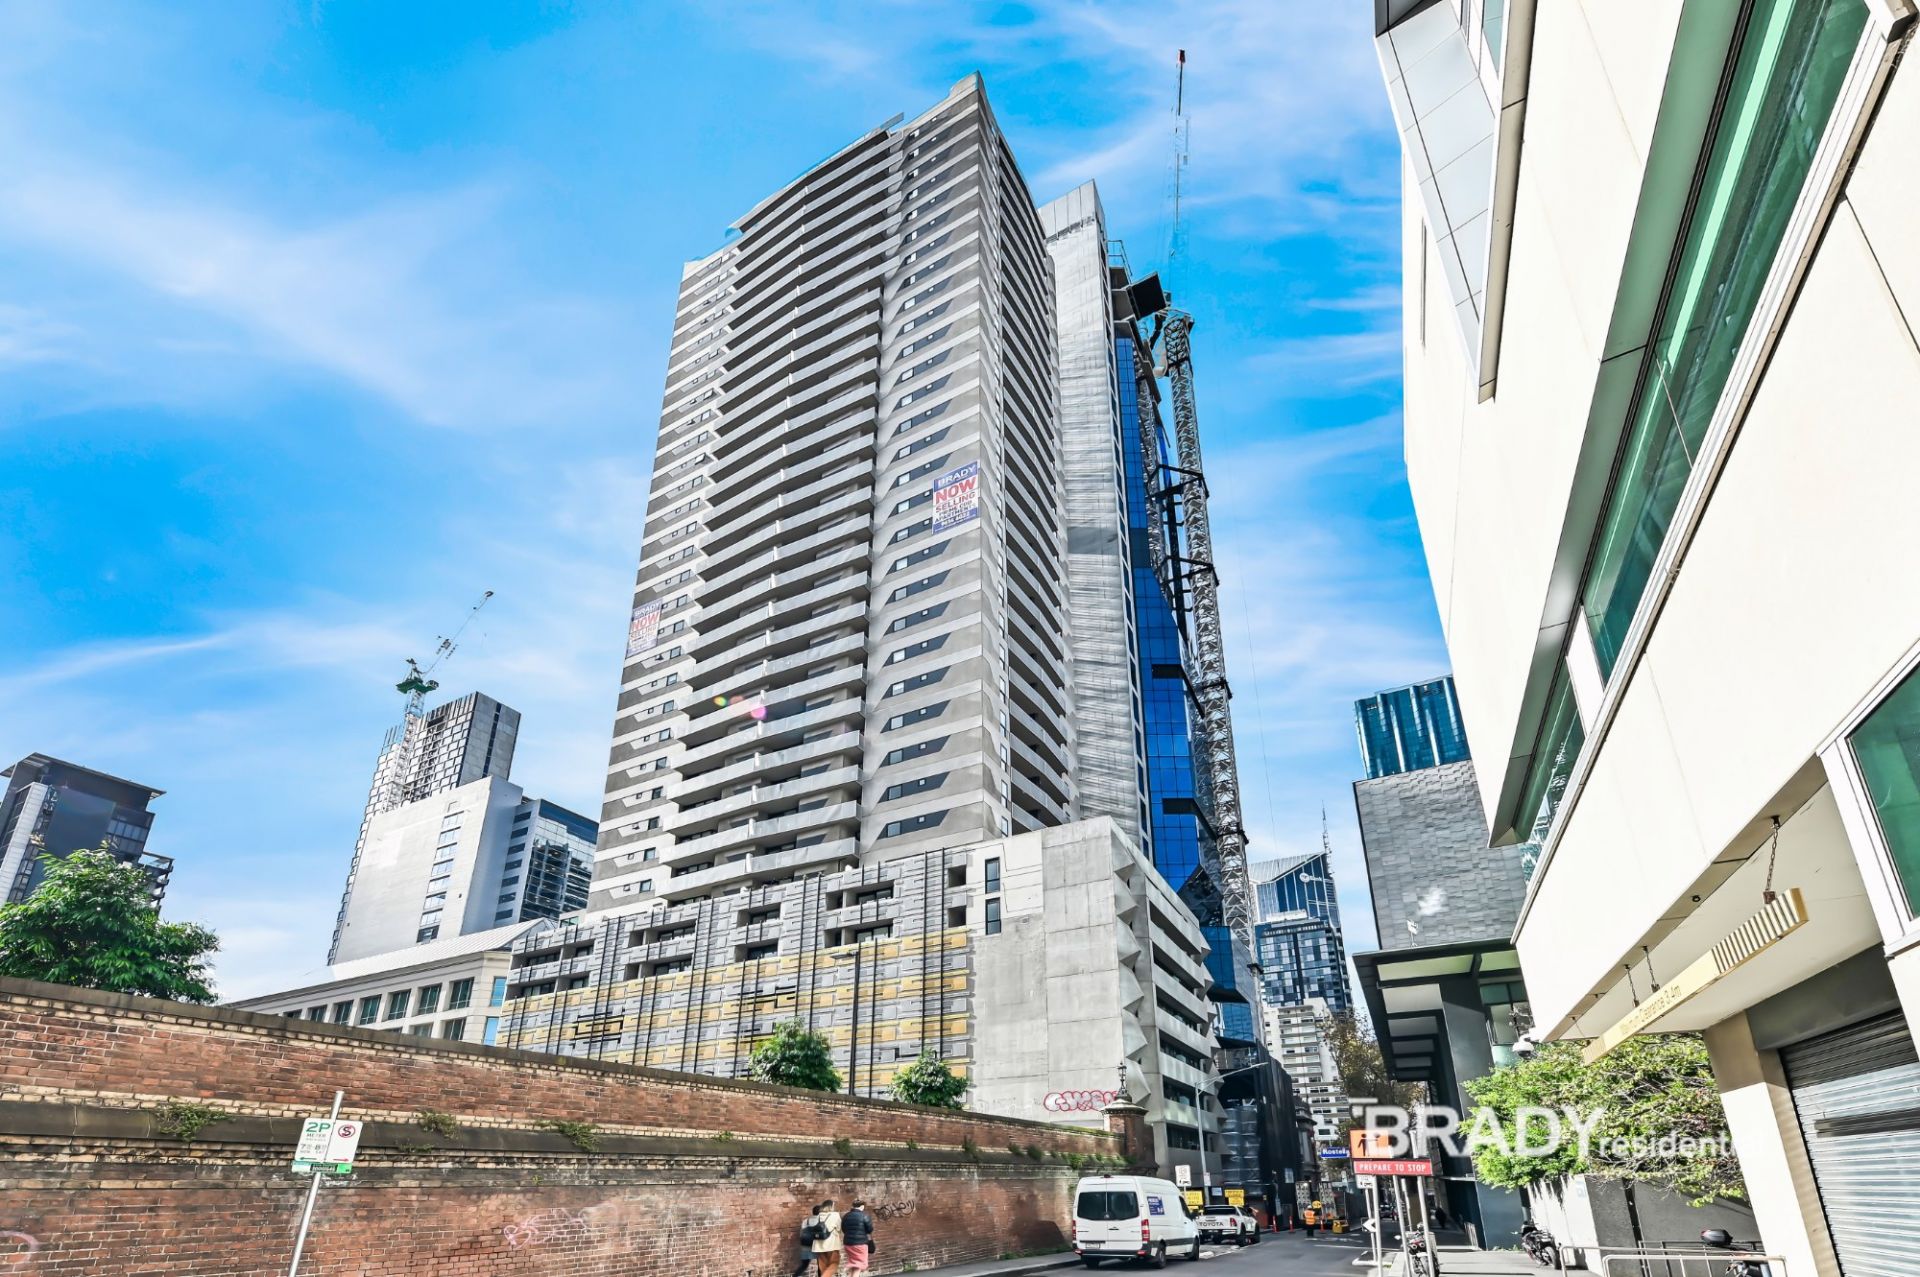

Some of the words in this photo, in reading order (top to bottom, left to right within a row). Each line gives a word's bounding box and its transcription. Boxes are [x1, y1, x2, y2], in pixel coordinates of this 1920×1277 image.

[936, 477, 976, 504] NOW
[936, 491, 976, 513] SELLING
[632, 611, 659, 632] NOW
[306, 1122, 330, 1132] 2P
[1359, 1163, 1391, 1172] PREPARE
